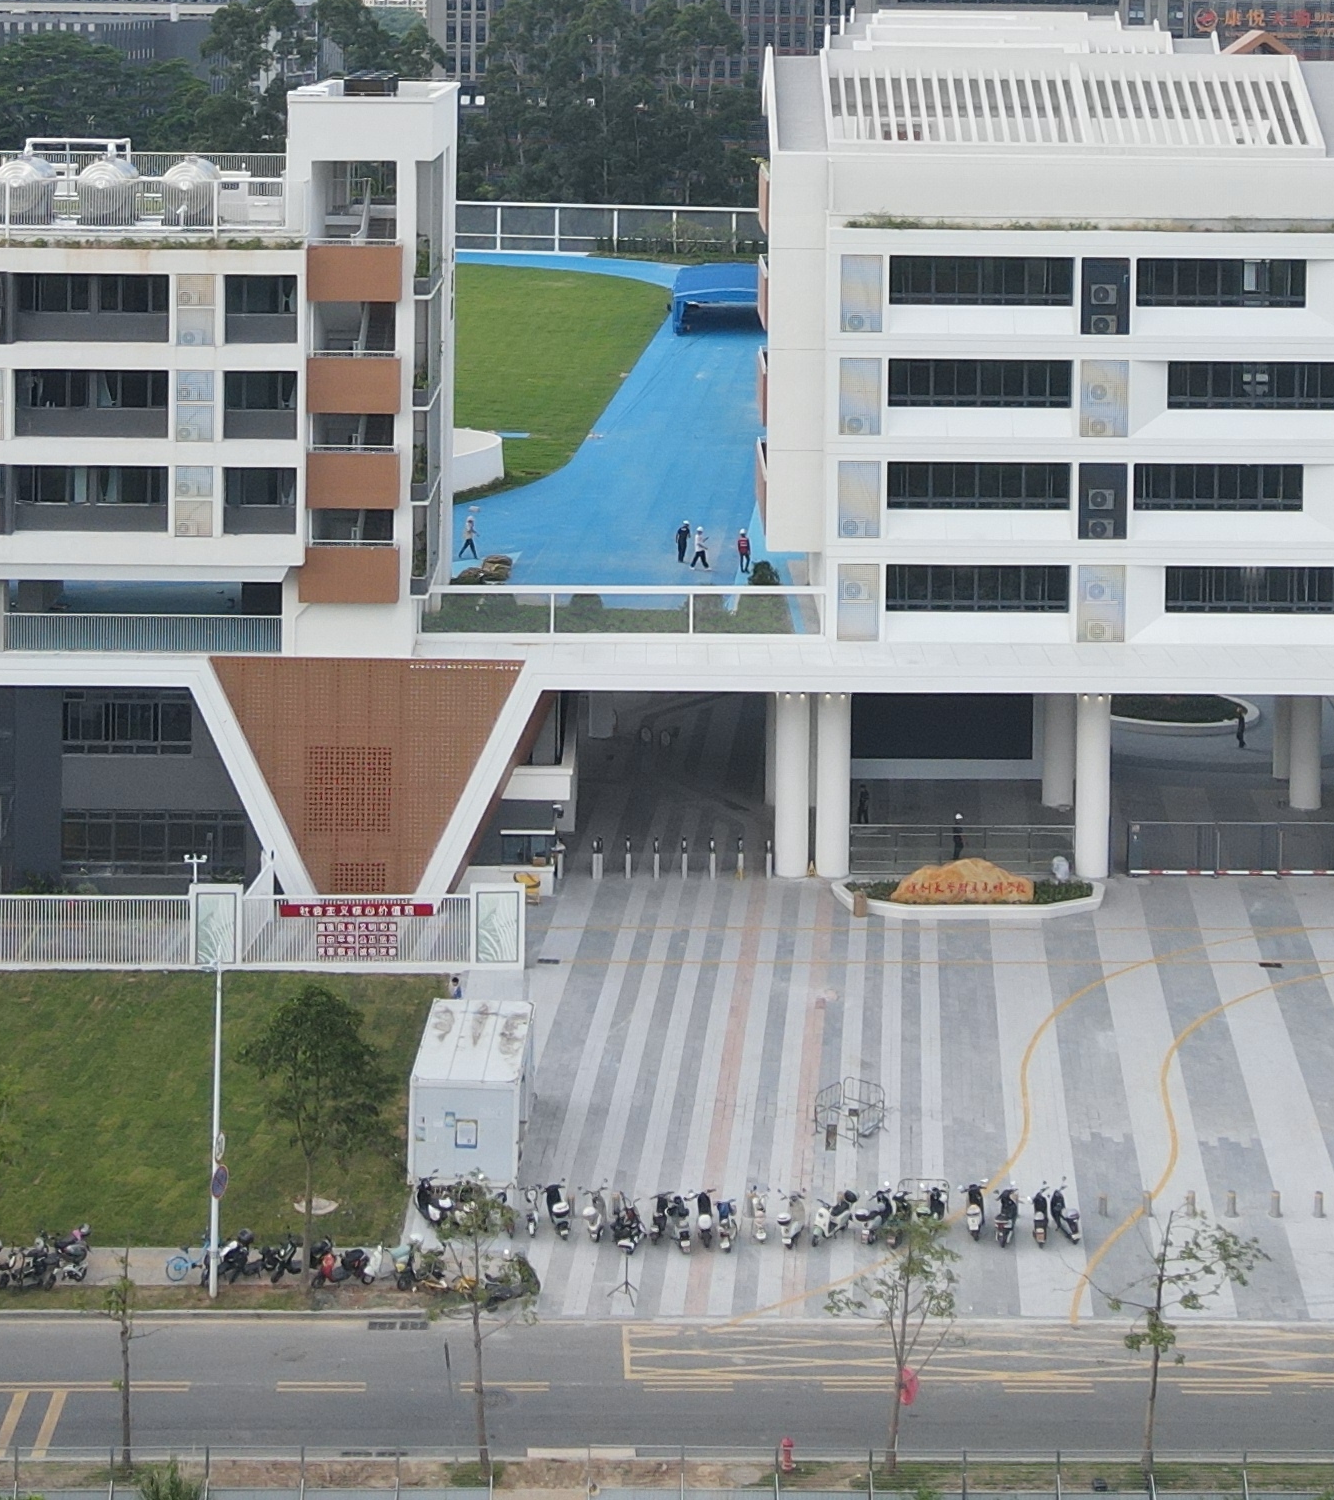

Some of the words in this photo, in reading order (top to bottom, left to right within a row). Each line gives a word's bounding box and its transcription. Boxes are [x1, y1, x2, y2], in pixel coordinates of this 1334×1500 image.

[299, 904, 415, 916] 社会主义核心价值观
